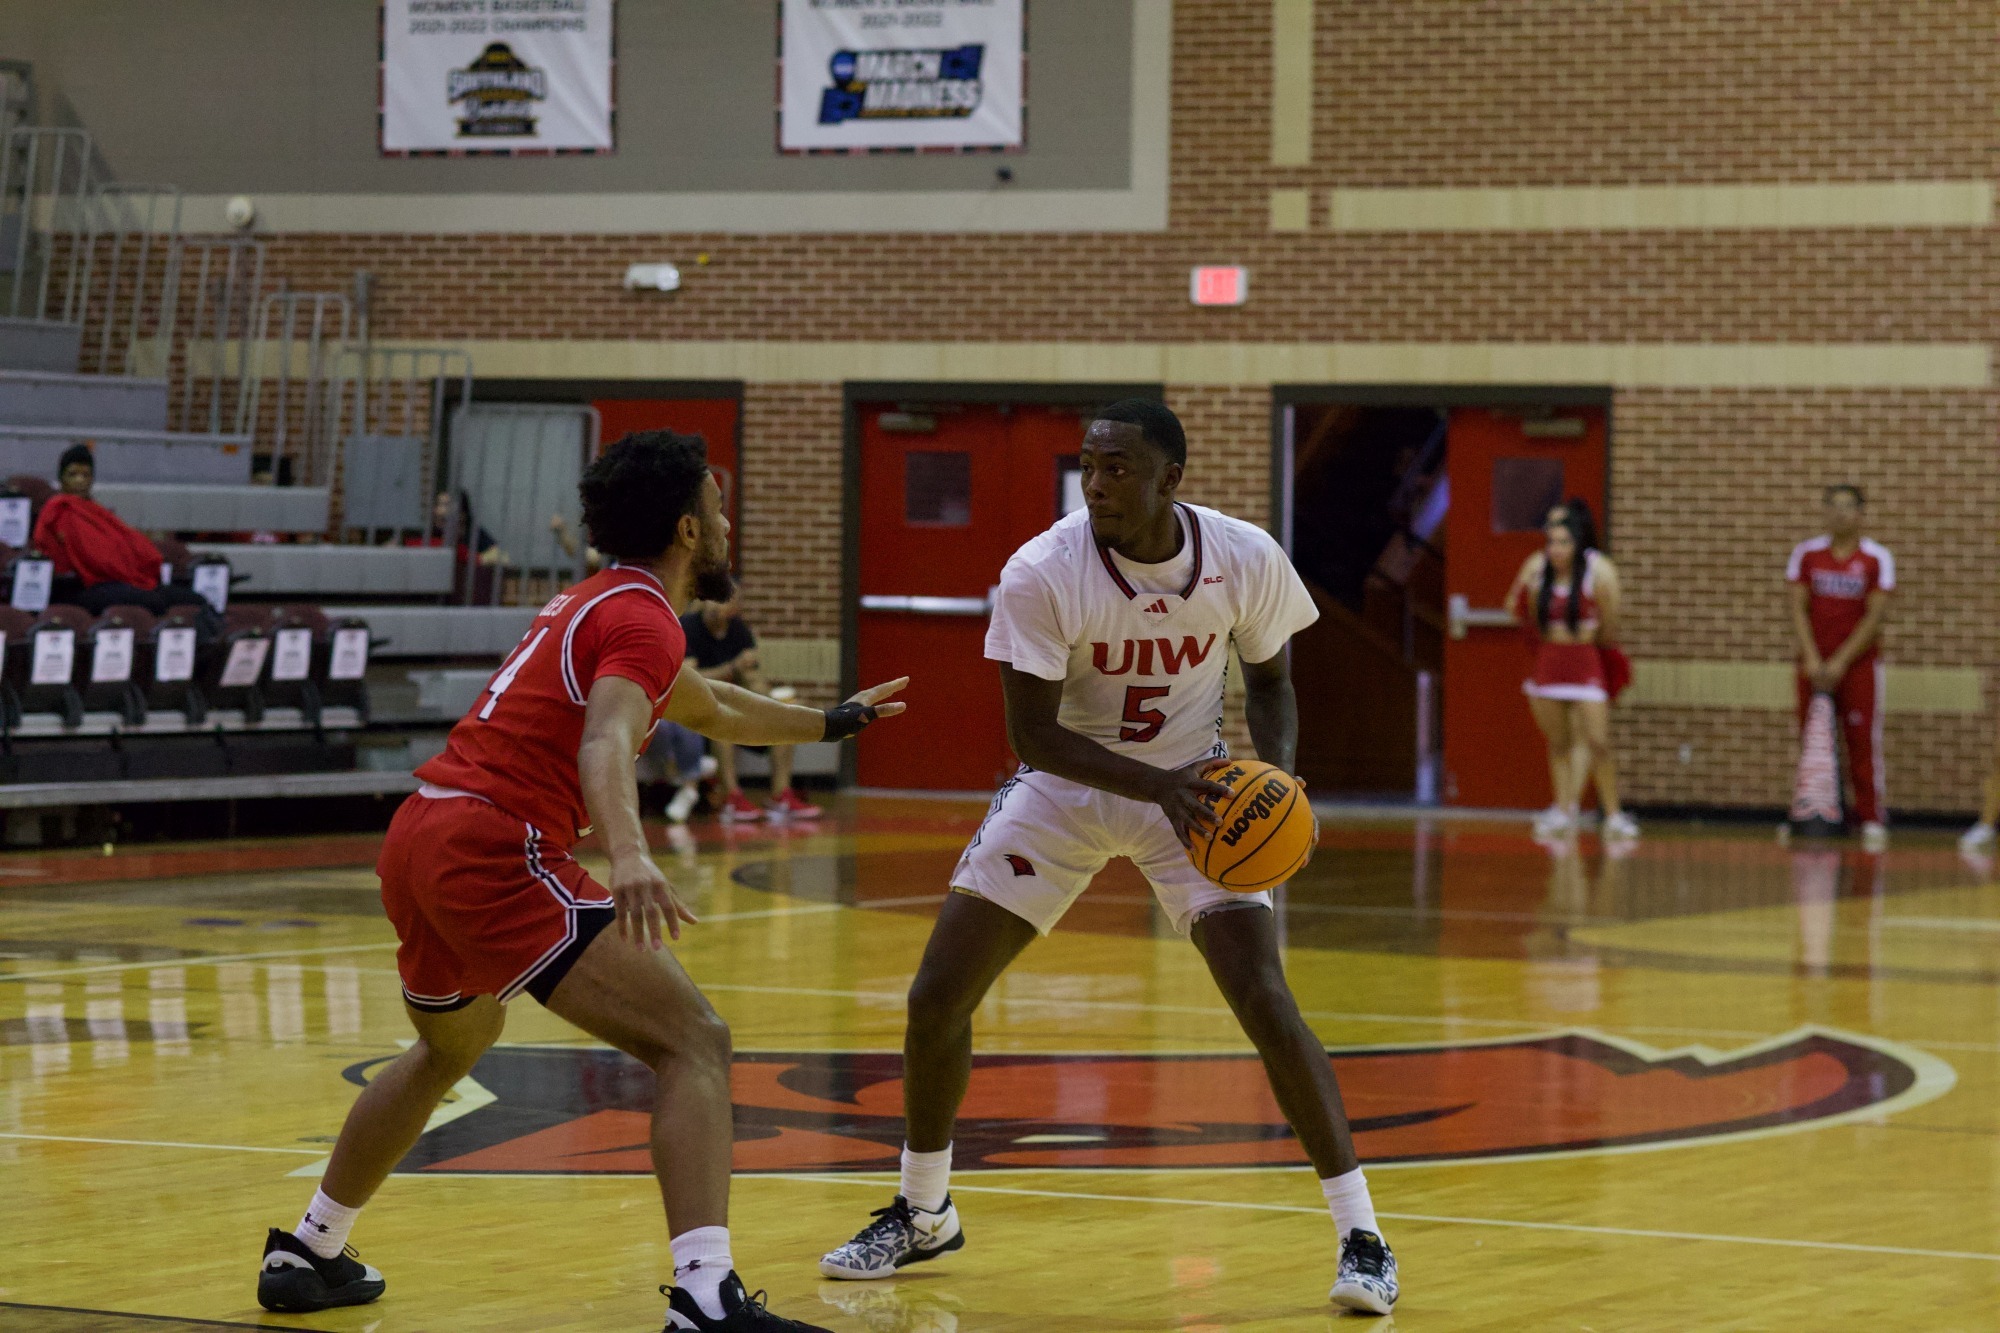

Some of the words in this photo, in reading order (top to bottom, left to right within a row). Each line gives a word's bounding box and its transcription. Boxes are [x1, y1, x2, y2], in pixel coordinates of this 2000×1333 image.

[491, 16, 586, 33] CHAMPIONS
[856, 51, 942, 79] MARCH
[864, 79, 982, 109] MADNESS
[1203, 575, 1225, 585] SLC
[1090, 633, 1217, 675] UIW
[1119, 684, 1171, 742] 5
[1220, 778, 1290, 847] Wilson
